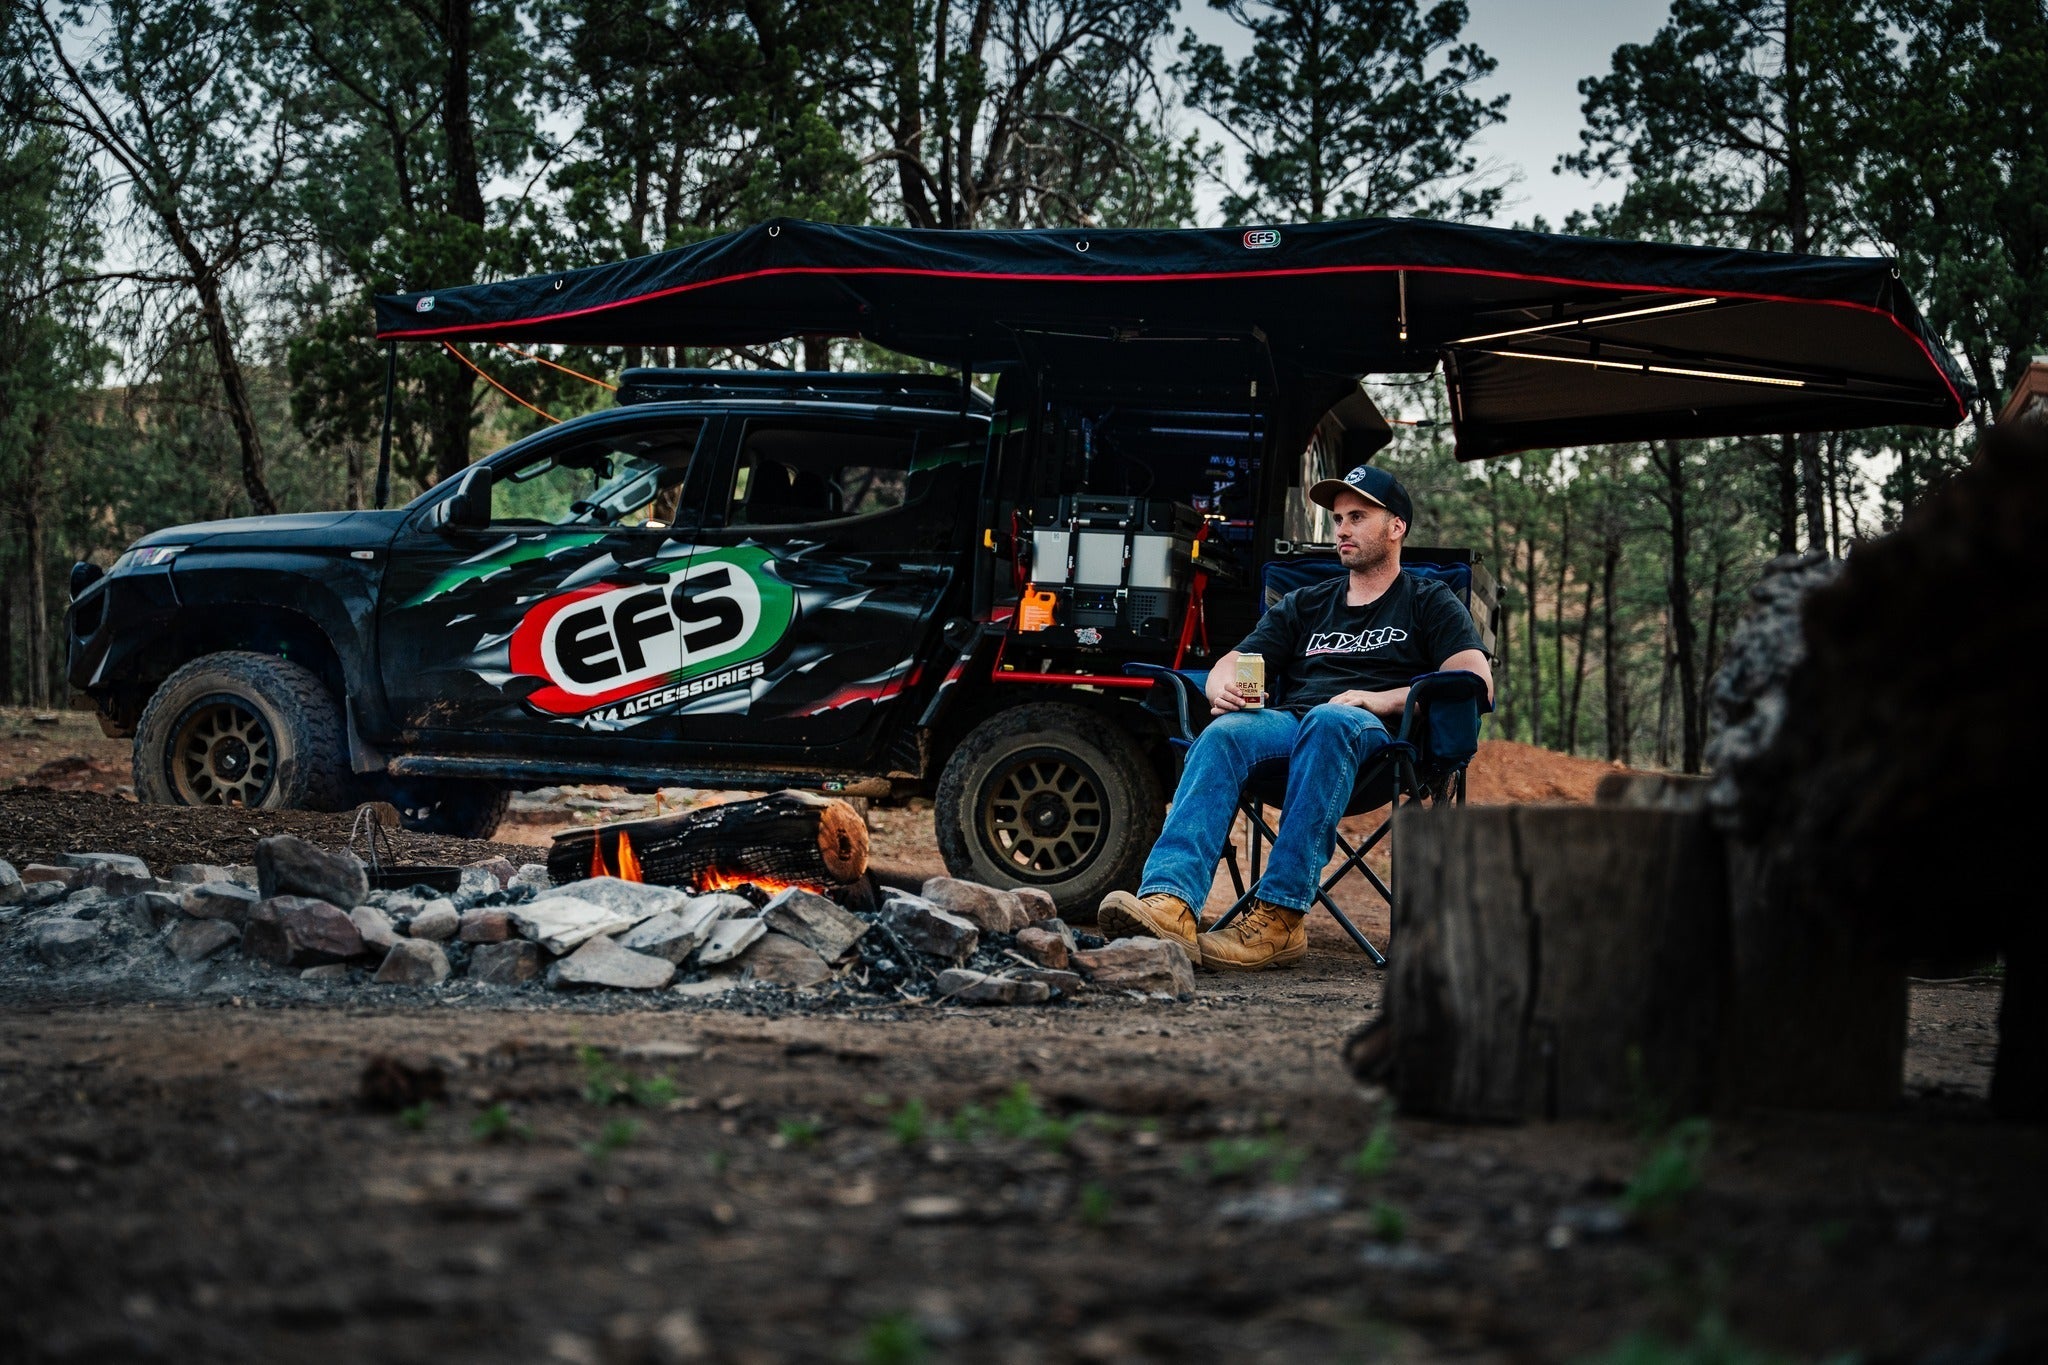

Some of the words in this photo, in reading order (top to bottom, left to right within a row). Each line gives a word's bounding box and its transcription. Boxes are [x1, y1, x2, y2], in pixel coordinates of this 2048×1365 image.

[1250, 233, 1274, 243] EFS
[555, 568, 744, 684] EFS
[623, 661, 765, 717] ACCESSORIES
